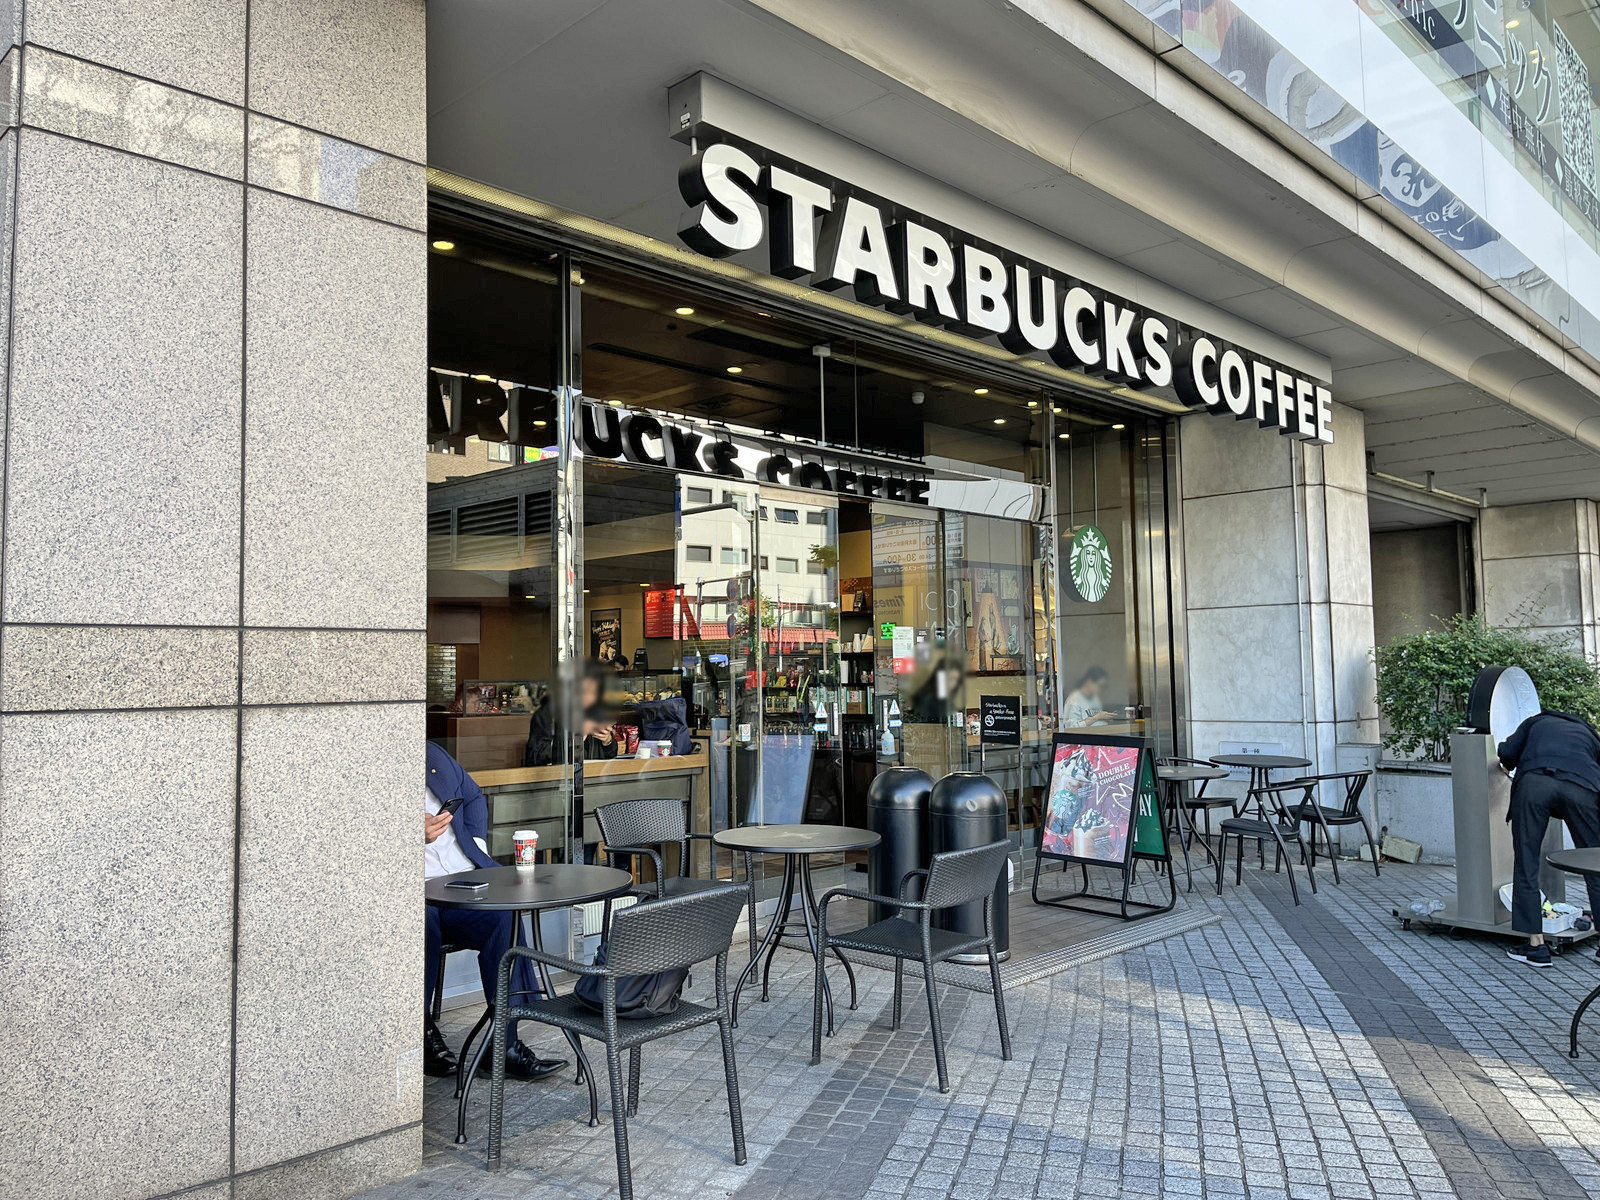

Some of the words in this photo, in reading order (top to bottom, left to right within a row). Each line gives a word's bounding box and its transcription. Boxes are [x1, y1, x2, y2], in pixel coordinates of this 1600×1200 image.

[690, 143, 1172, 390] STARBUCKS
[1185, 337, 1334, 446] COFFEE
[1098, 762, 1130, 780] DOUBLE
[1099, 769, 1136, 786] CHOCOLATE
